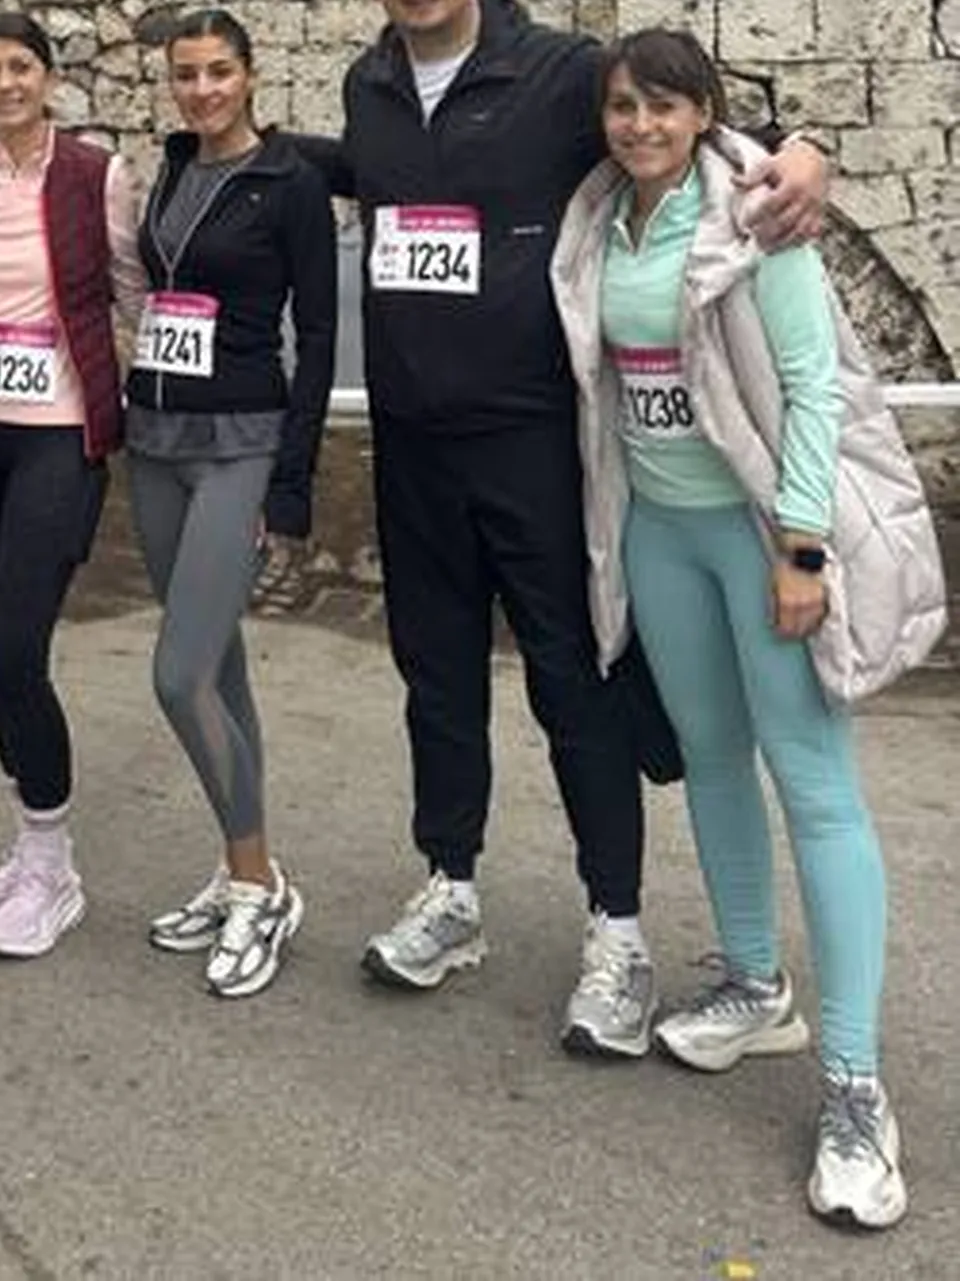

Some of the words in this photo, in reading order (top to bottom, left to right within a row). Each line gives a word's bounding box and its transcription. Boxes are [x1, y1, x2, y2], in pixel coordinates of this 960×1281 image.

[407, 242, 470, 283] 1234
[153, 327, 202, 366] 1241
[627, 386, 694, 428] 1238
